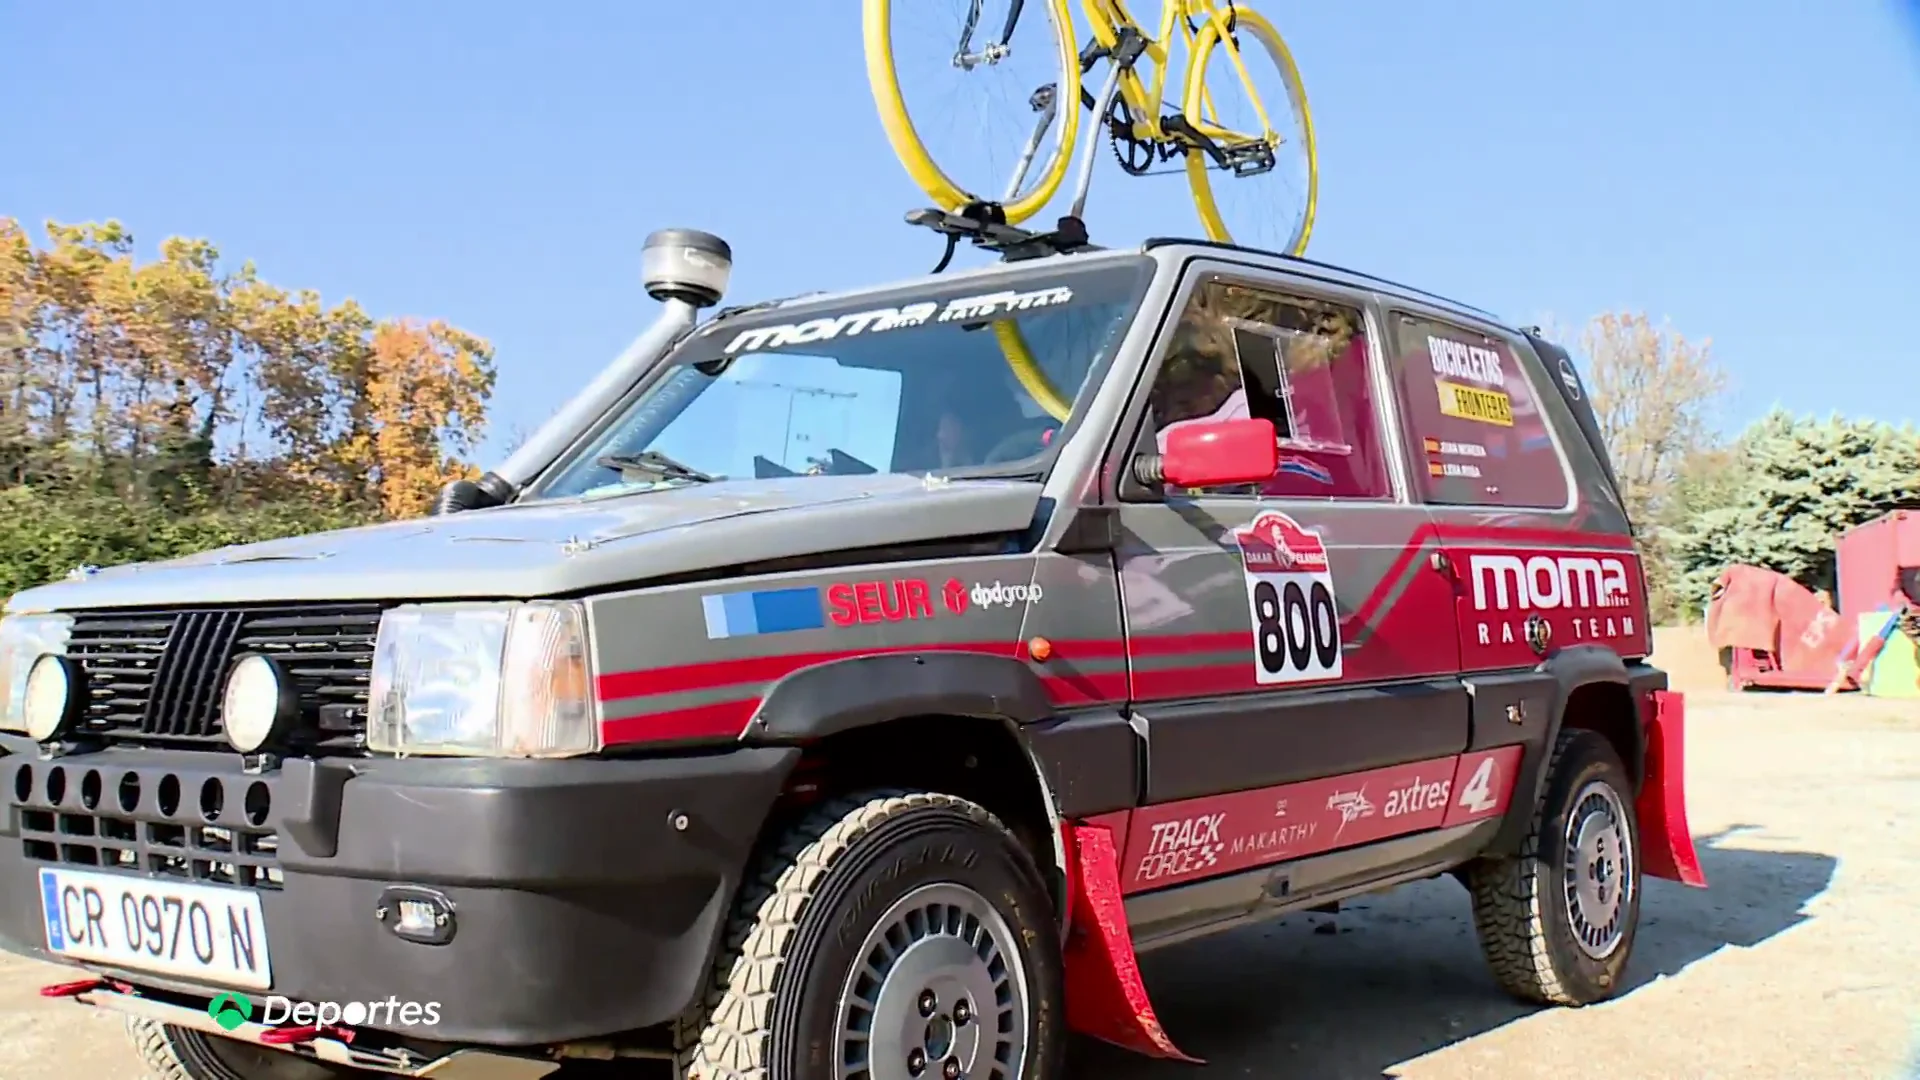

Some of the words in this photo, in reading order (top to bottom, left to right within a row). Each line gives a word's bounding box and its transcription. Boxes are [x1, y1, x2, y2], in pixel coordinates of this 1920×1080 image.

[725, 302, 937, 354] moma
[1428, 335, 1504, 387] BICICLETAS
[1455, 388, 1511, 422] FRONTERAS
[827, 579, 934, 628] SEUR
[971, 579, 1042, 609] dpdgroup
[1470, 555, 1628, 610] moma
[1255, 581, 1337, 673] 800
[1573, 617, 1634, 639] TEAM
[1384, 776, 1452, 818] axtres
[1459, 757, 1497, 813] 4
[1149, 812, 1226, 854] TRACK
[1230, 822, 1318, 855] MAKARTHY
[1136, 847, 1199, 882] FORCE
[63, 885, 108, 949] CR
[121, 891, 214, 965] 0970
[228, 905, 257, 973] N
